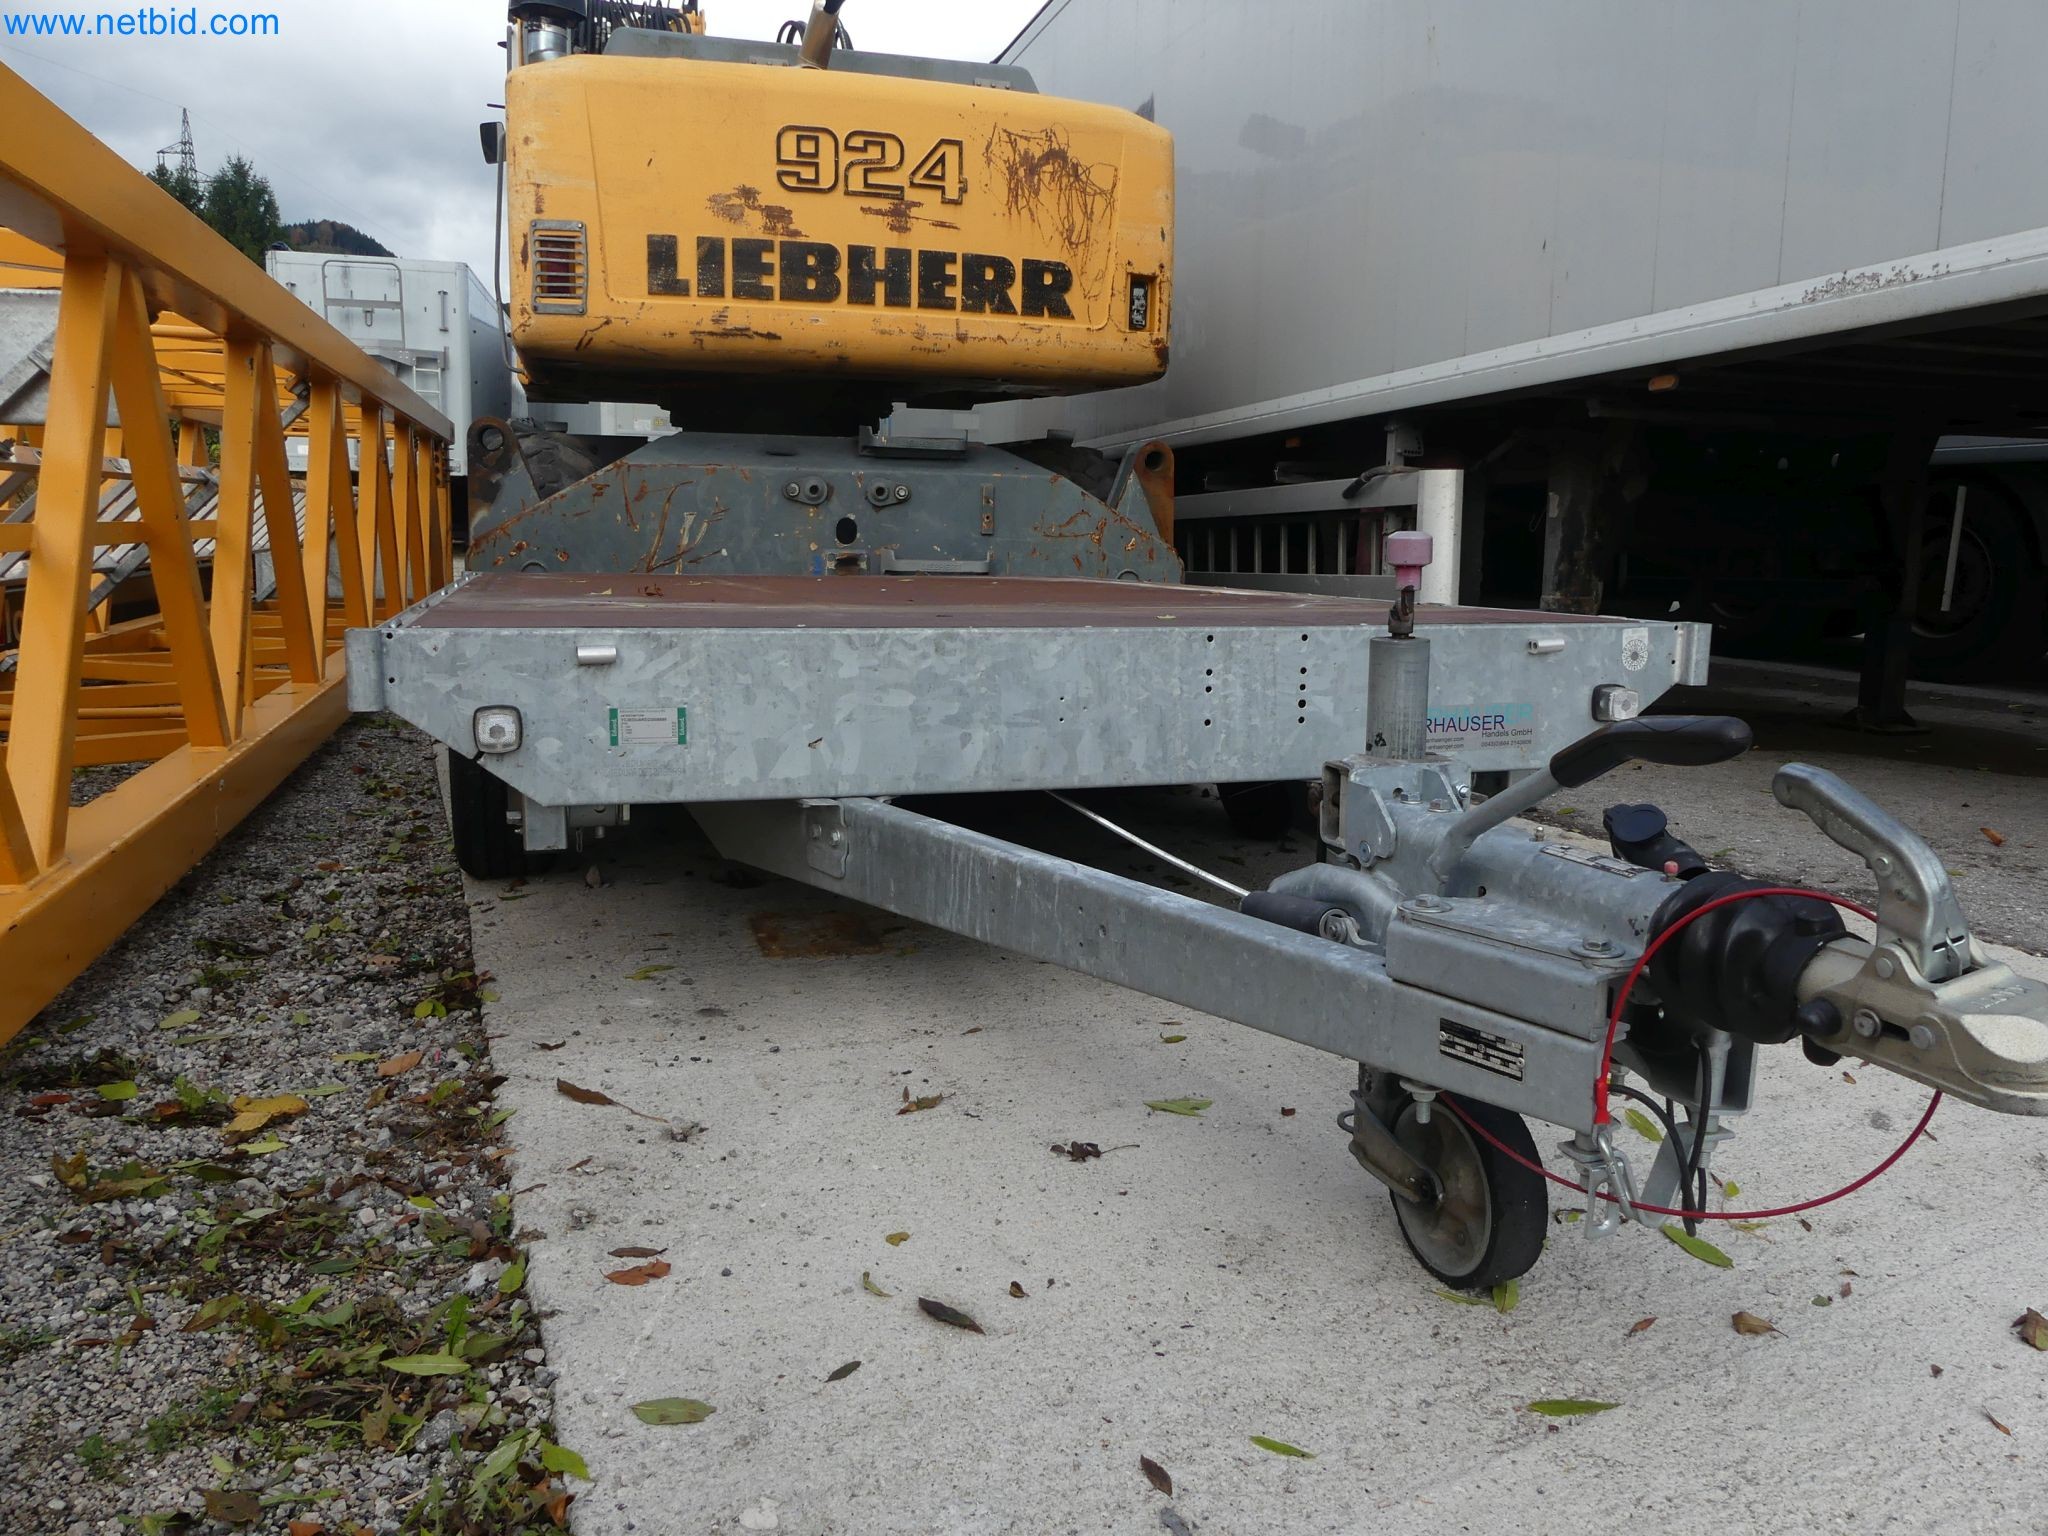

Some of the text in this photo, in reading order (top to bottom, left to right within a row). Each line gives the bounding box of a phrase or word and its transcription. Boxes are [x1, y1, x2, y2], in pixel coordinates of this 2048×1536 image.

[776, 124, 968, 205] 924
[647, 234, 1076, 320] LIEBHERR
[1482, 728, 1533, 738] Handels GmbH
